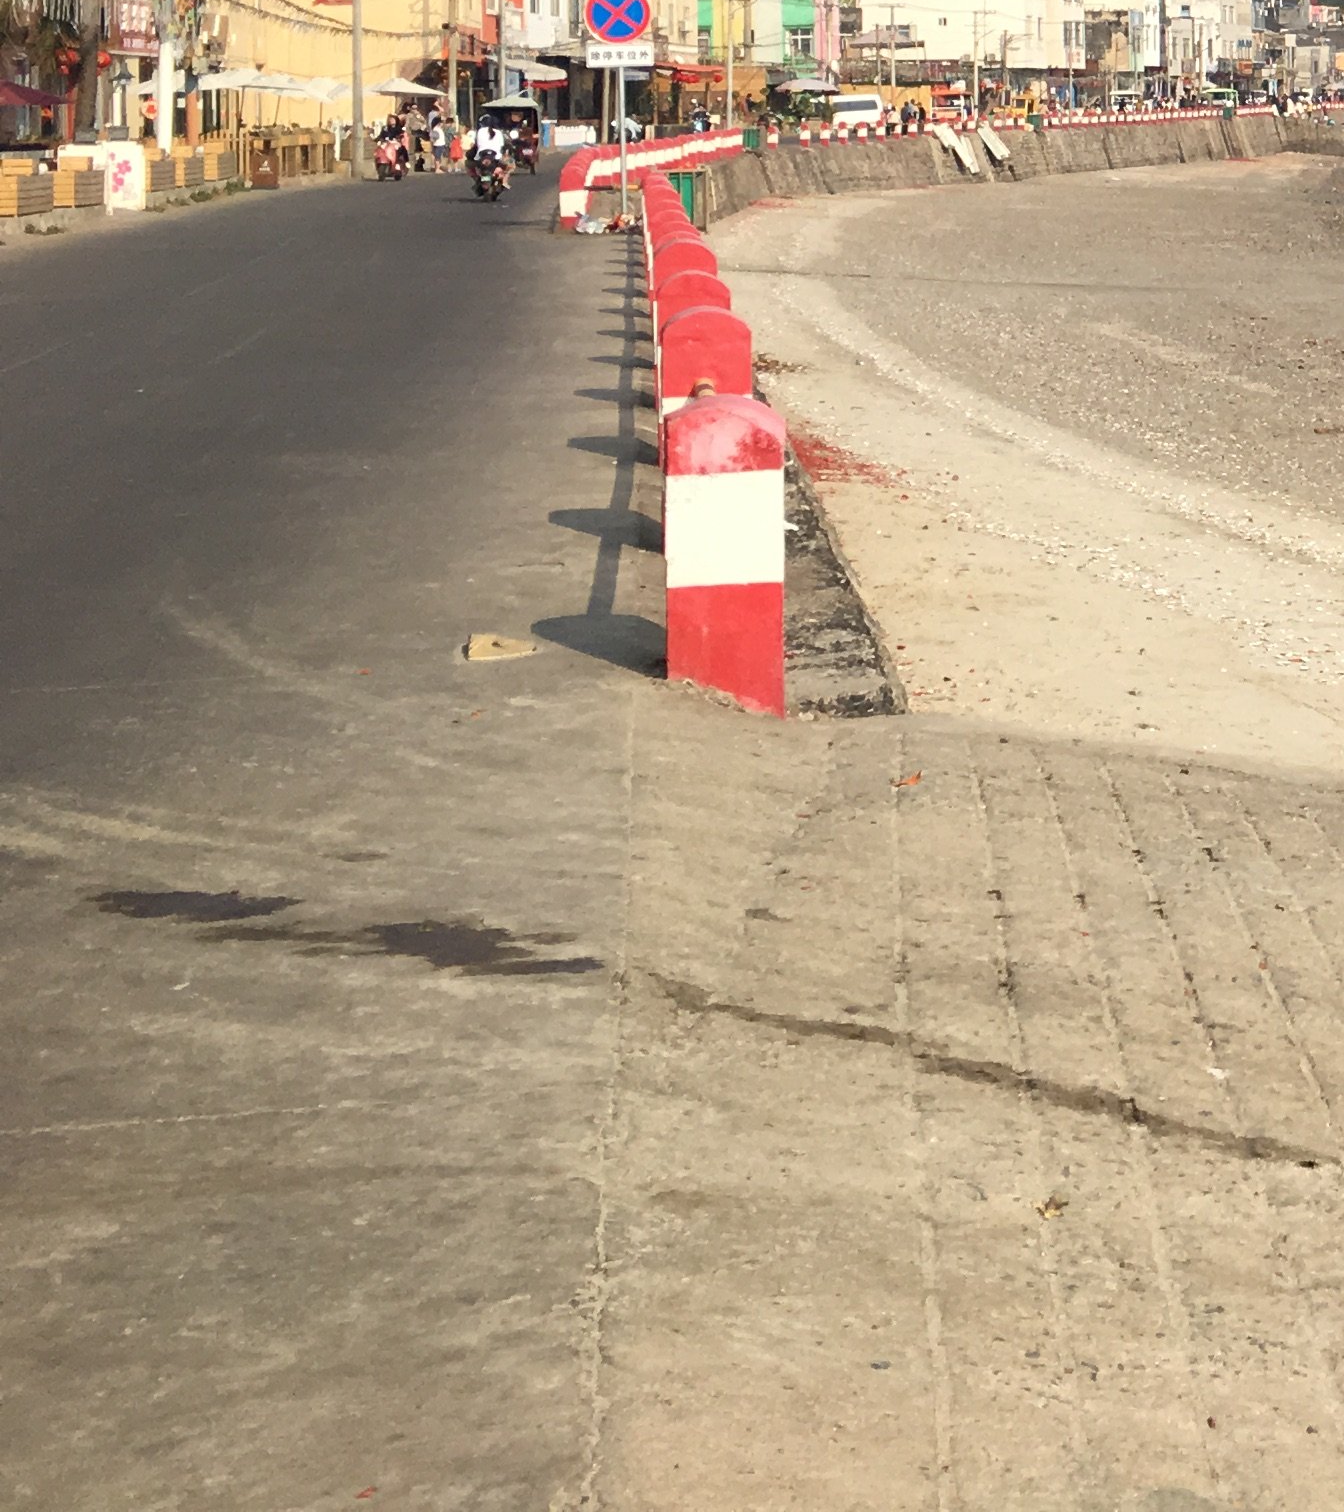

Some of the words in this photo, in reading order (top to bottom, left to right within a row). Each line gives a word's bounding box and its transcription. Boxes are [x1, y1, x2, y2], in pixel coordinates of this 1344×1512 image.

[590, 50, 649, 60] 除停车位外
